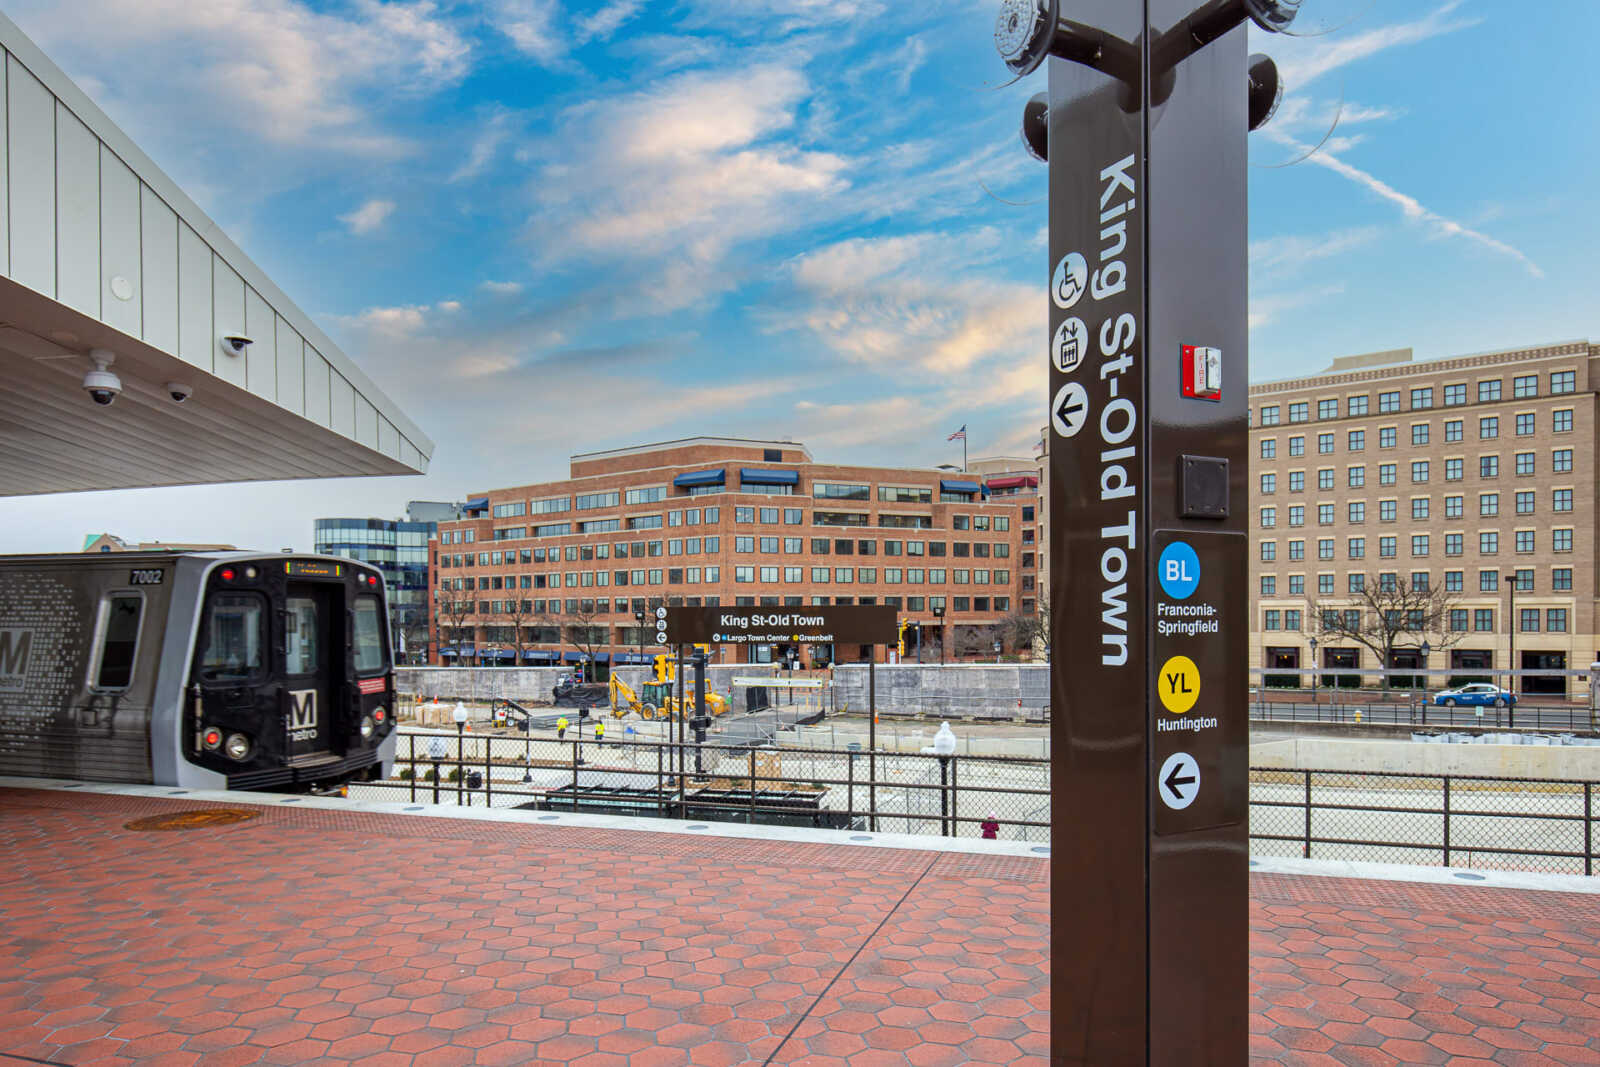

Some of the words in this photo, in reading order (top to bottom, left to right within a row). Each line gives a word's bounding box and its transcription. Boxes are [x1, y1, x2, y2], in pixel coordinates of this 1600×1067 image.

[1090, 153, 1137, 301] King
[1100, 312, 1137, 501] St-Old
[132, 569, 162, 584] 7002
[1166, 560, 1192, 581] BL
[1101, 510, 1136, 666] Town
[1158, 602, 1217, 616] Franconia-
[720, 615, 749, 628] King
[751, 614, 790, 626] St-Old
[791, 615, 825, 626] Town
[1158, 619, 1219, 636] Springfield
[727, 634, 747, 643] Largo
[747, 634, 766, 642] Town
[767, 634, 790, 642] Center
[799, 634, 834, 642] Greenbelt
[1167, 673, 1192, 694] YL
[1158, 716, 1218, 732] Huntington
